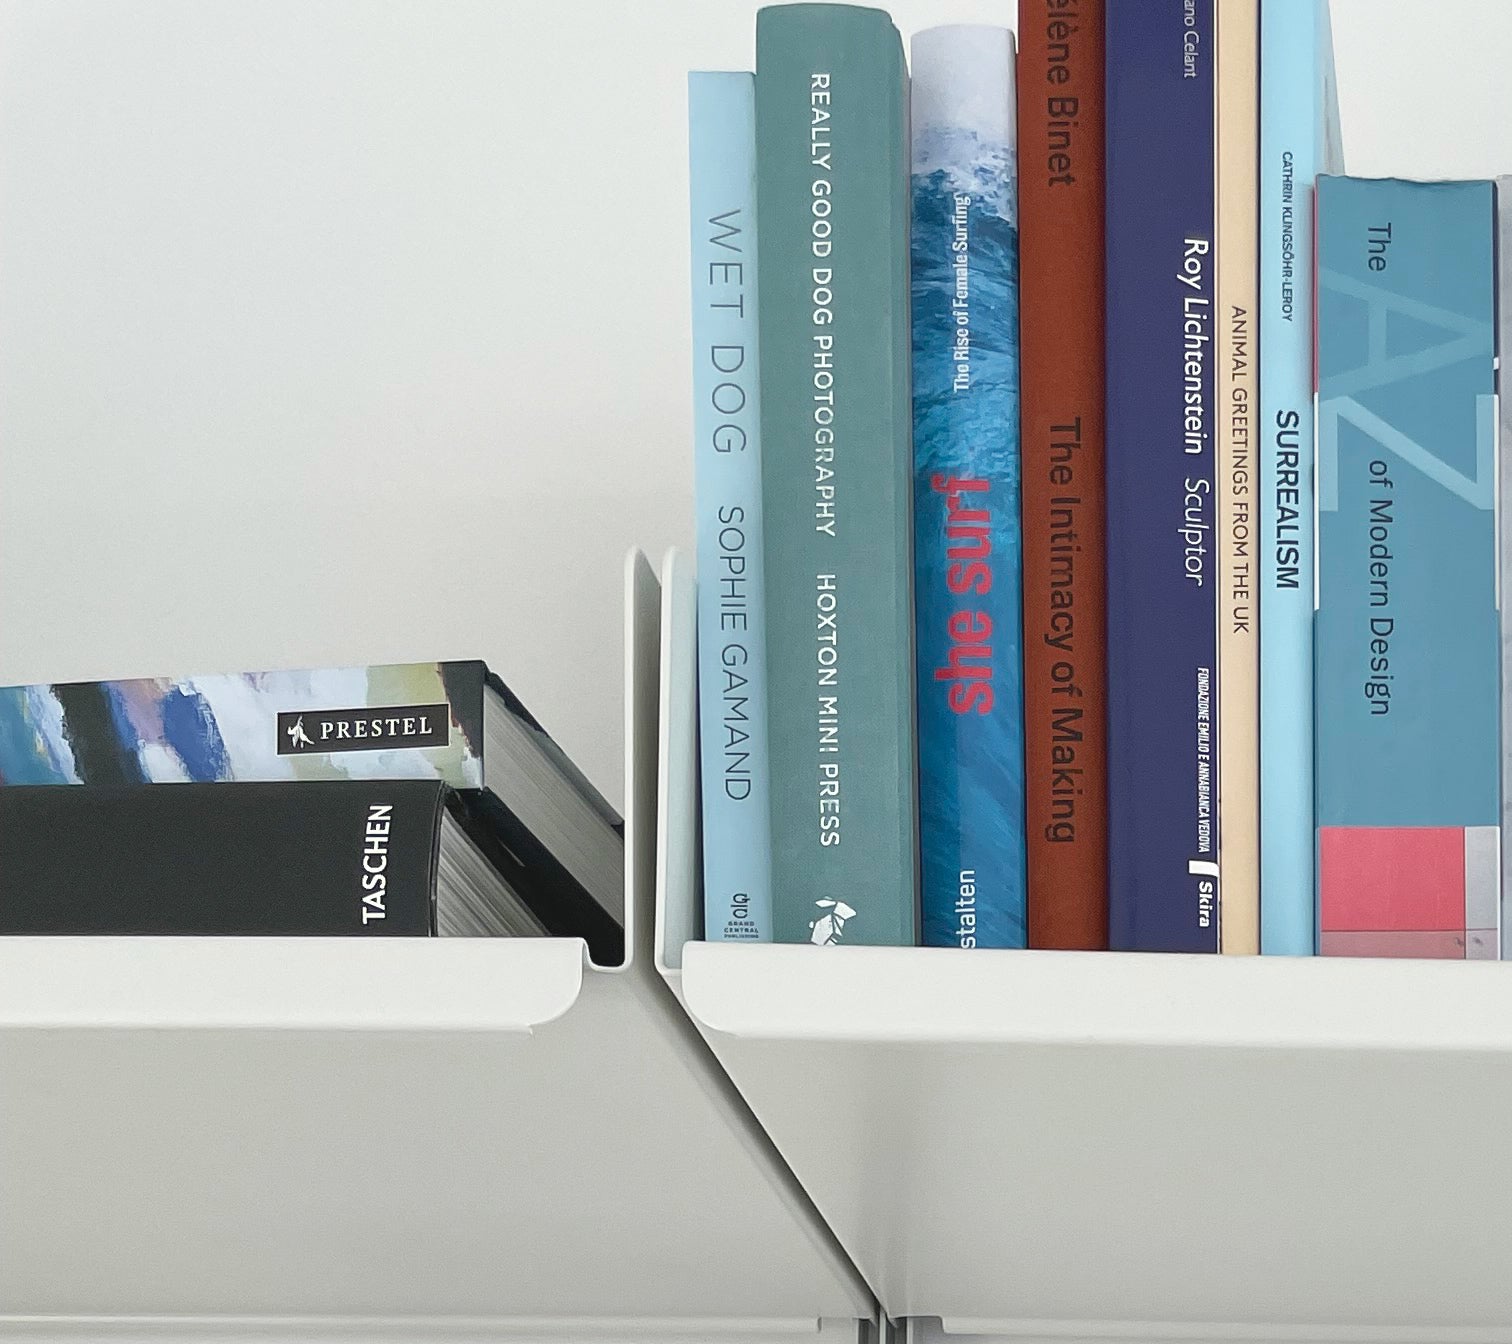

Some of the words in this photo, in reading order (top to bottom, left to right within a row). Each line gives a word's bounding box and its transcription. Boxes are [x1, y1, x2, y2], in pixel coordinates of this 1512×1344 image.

[809, 73, 832, 170] REALLY
[1280, 151, 1294, 203] CATHRIN
[811, 180, 833, 257] GOOD
[952, 196, 973, 253] Surfing
[1366, 222, 1394, 270] The
[707, 210, 745, 319] WET
[811, 268, 833, 325] DOG
[953, 258, 971, 307] Female
[1178, 239, 1209, 288] Roy
[1280, 206, 1296, 322] KLINGSÖHR-LEROY
[952, 327, 971, 362] Rise
[953, 311, 972, 323] of
[1229, 306, 1250, 381] ANIMAL
[711, 345, 747, 454] DOG
[953, 365, 972, 392] The
[1184, 297, 1210, 454] Lichtenstein
[811, 335, 836, 537] PHOTOGRAPHY
[1046, 417, 1083, 486] The
[1229, 388, 1250, 496] GREETINGS
[1367, 459, 1395, 486] of
[932, 474, 995, 594] surf
[1178, 478, 1210, 586] Sculptor
[1229, 502, 1250, 556] FROM
[1277, 409, 1300, 589] SURREALISM
[716, 505, 748, 630] SOPHIE
[1040, 496, 1084, 650] Intimacy
[1229, 563, 1250, 599] THE
[1367, 498, 1395, 606] Modern
[814, 573, 838, 687] HOXTON
[1230, 604, 1250, 633] UK
[934, 611, 995, 715] she
[1049, 659, 1085, 699] of
[1364, 617, 1395, 715] Design
[320, 716, 433, 741] PRESTEL
[720, 644, 750, 800] GAMAND
[816, 696, 839, 754] MINI
[817, 763, 841, 847] PRESS
[1041, 707, 1085, 843] Making
[362, 804, 393, 925] TASCHEN
[1198, 881, 1213, 927] Skira
